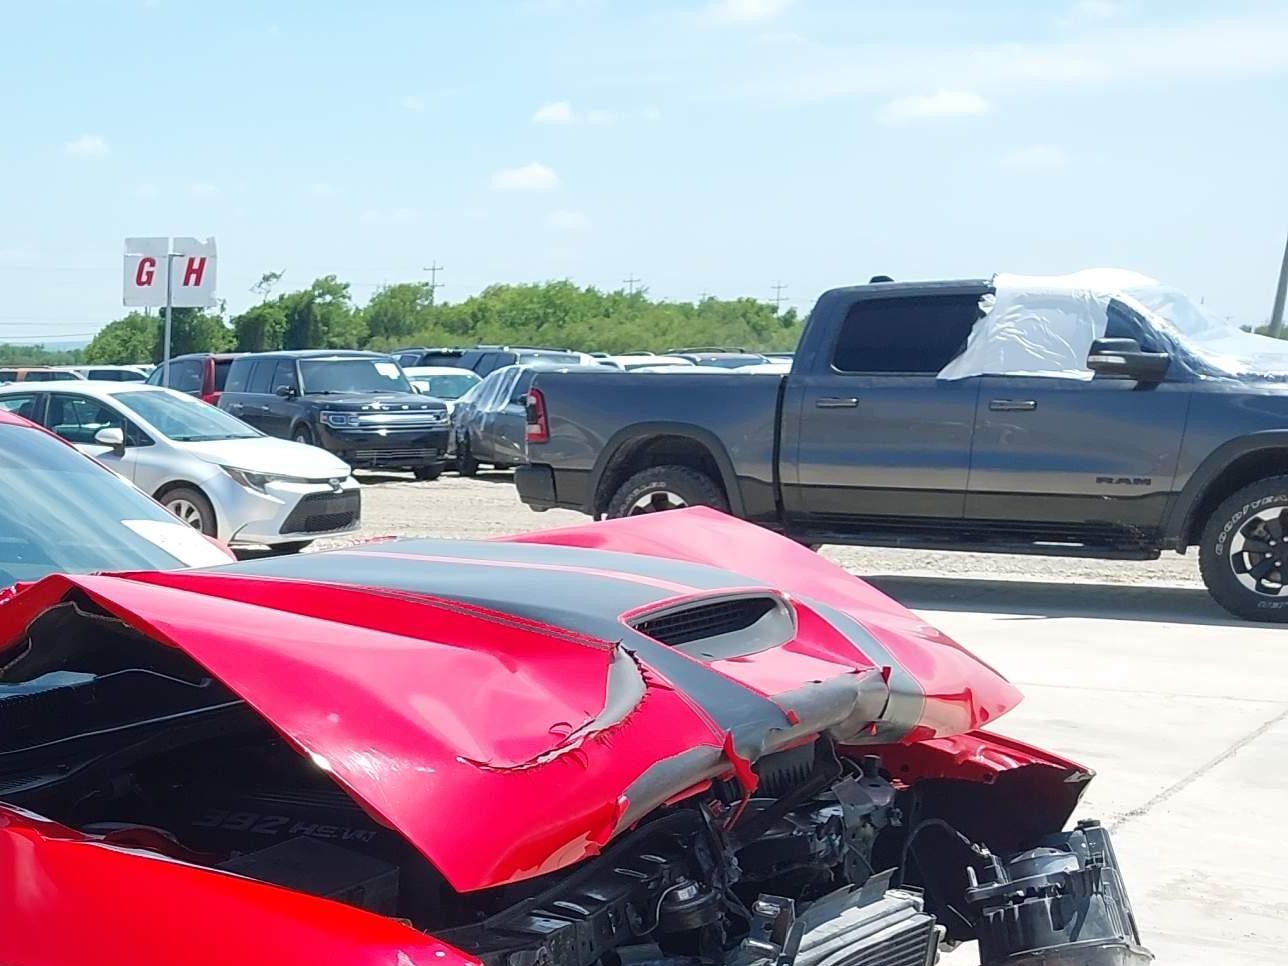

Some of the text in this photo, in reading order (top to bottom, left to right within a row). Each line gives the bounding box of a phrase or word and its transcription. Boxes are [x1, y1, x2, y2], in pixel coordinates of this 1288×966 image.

[136, 257, 156, 287] G
[183, 257, 206, 287] H
[1096, 477, 1151, 486] RAM
